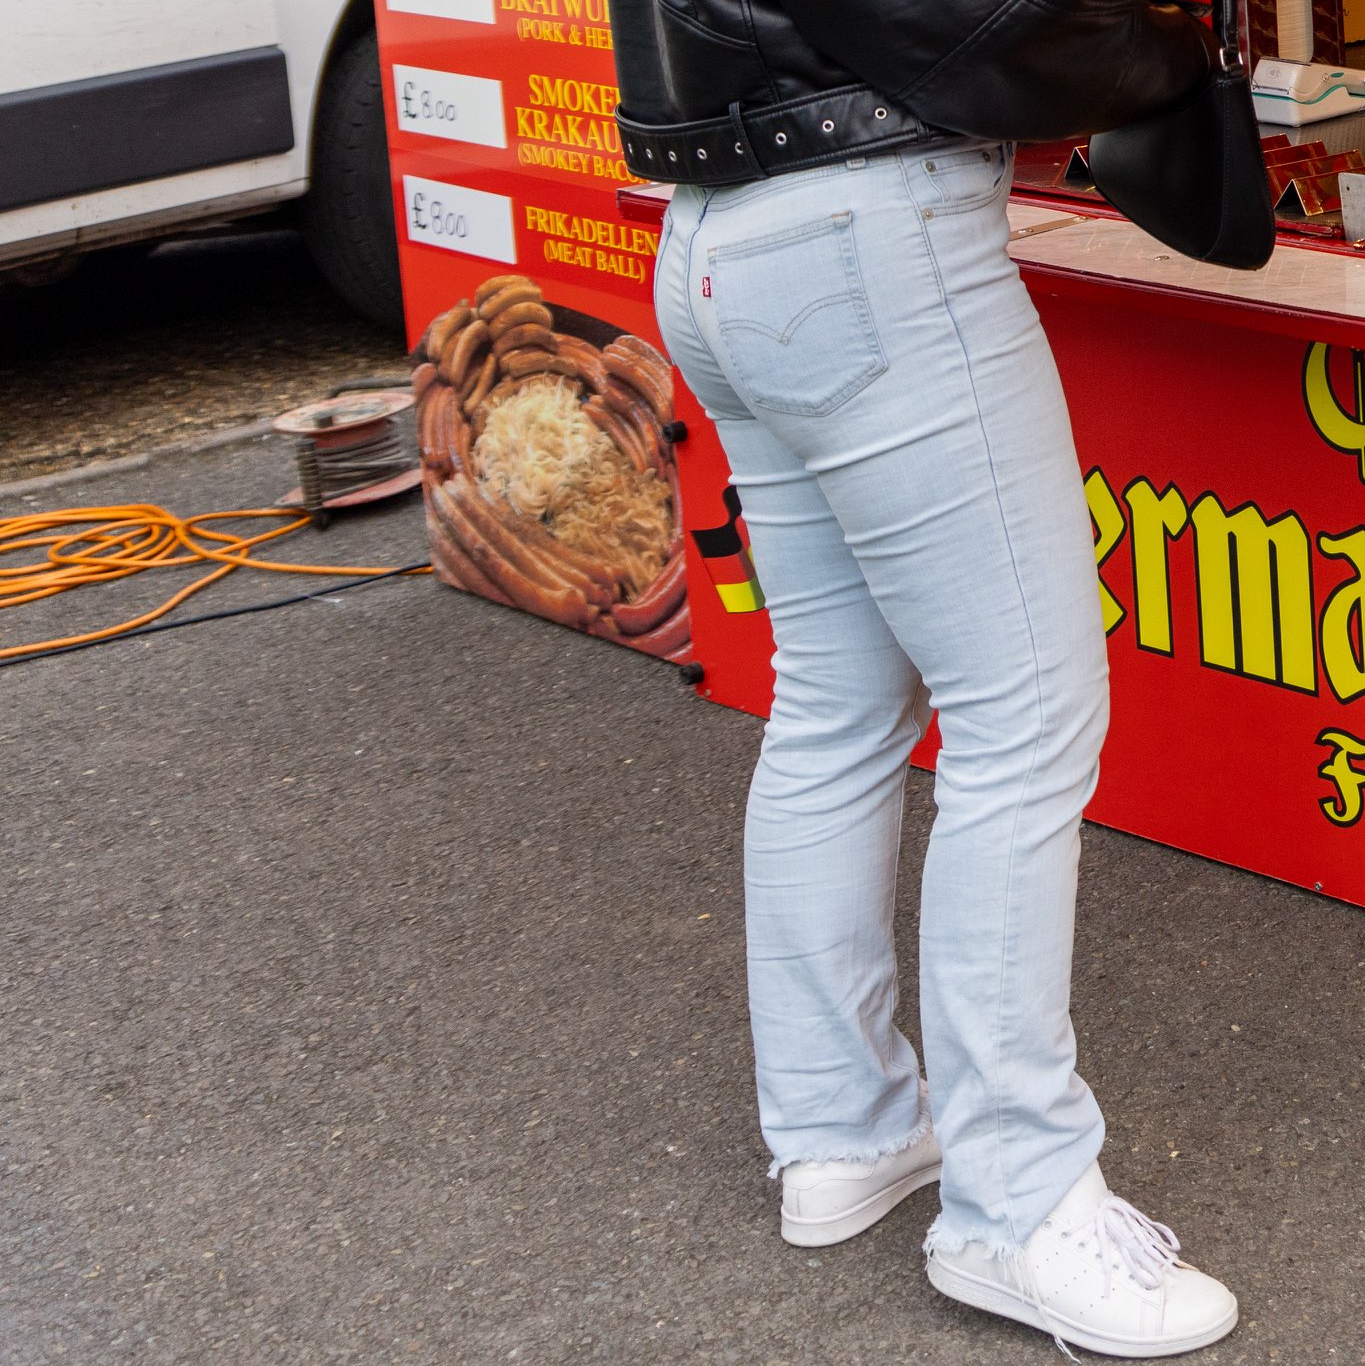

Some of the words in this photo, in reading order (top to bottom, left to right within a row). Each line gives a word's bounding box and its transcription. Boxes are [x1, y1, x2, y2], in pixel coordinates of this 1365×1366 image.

[517, 18, 567, 43] (PORK
[568, 24, 583, 45] &
[515, 107, 622, 154] KRAKAU
[518, 142, 591, 175] (SMOKEY
[525, 205, 659, 256] FRIKADELLEN
[543, 239, 593, 267] (MEAT
[596, 250, 646, 284] BALL)
